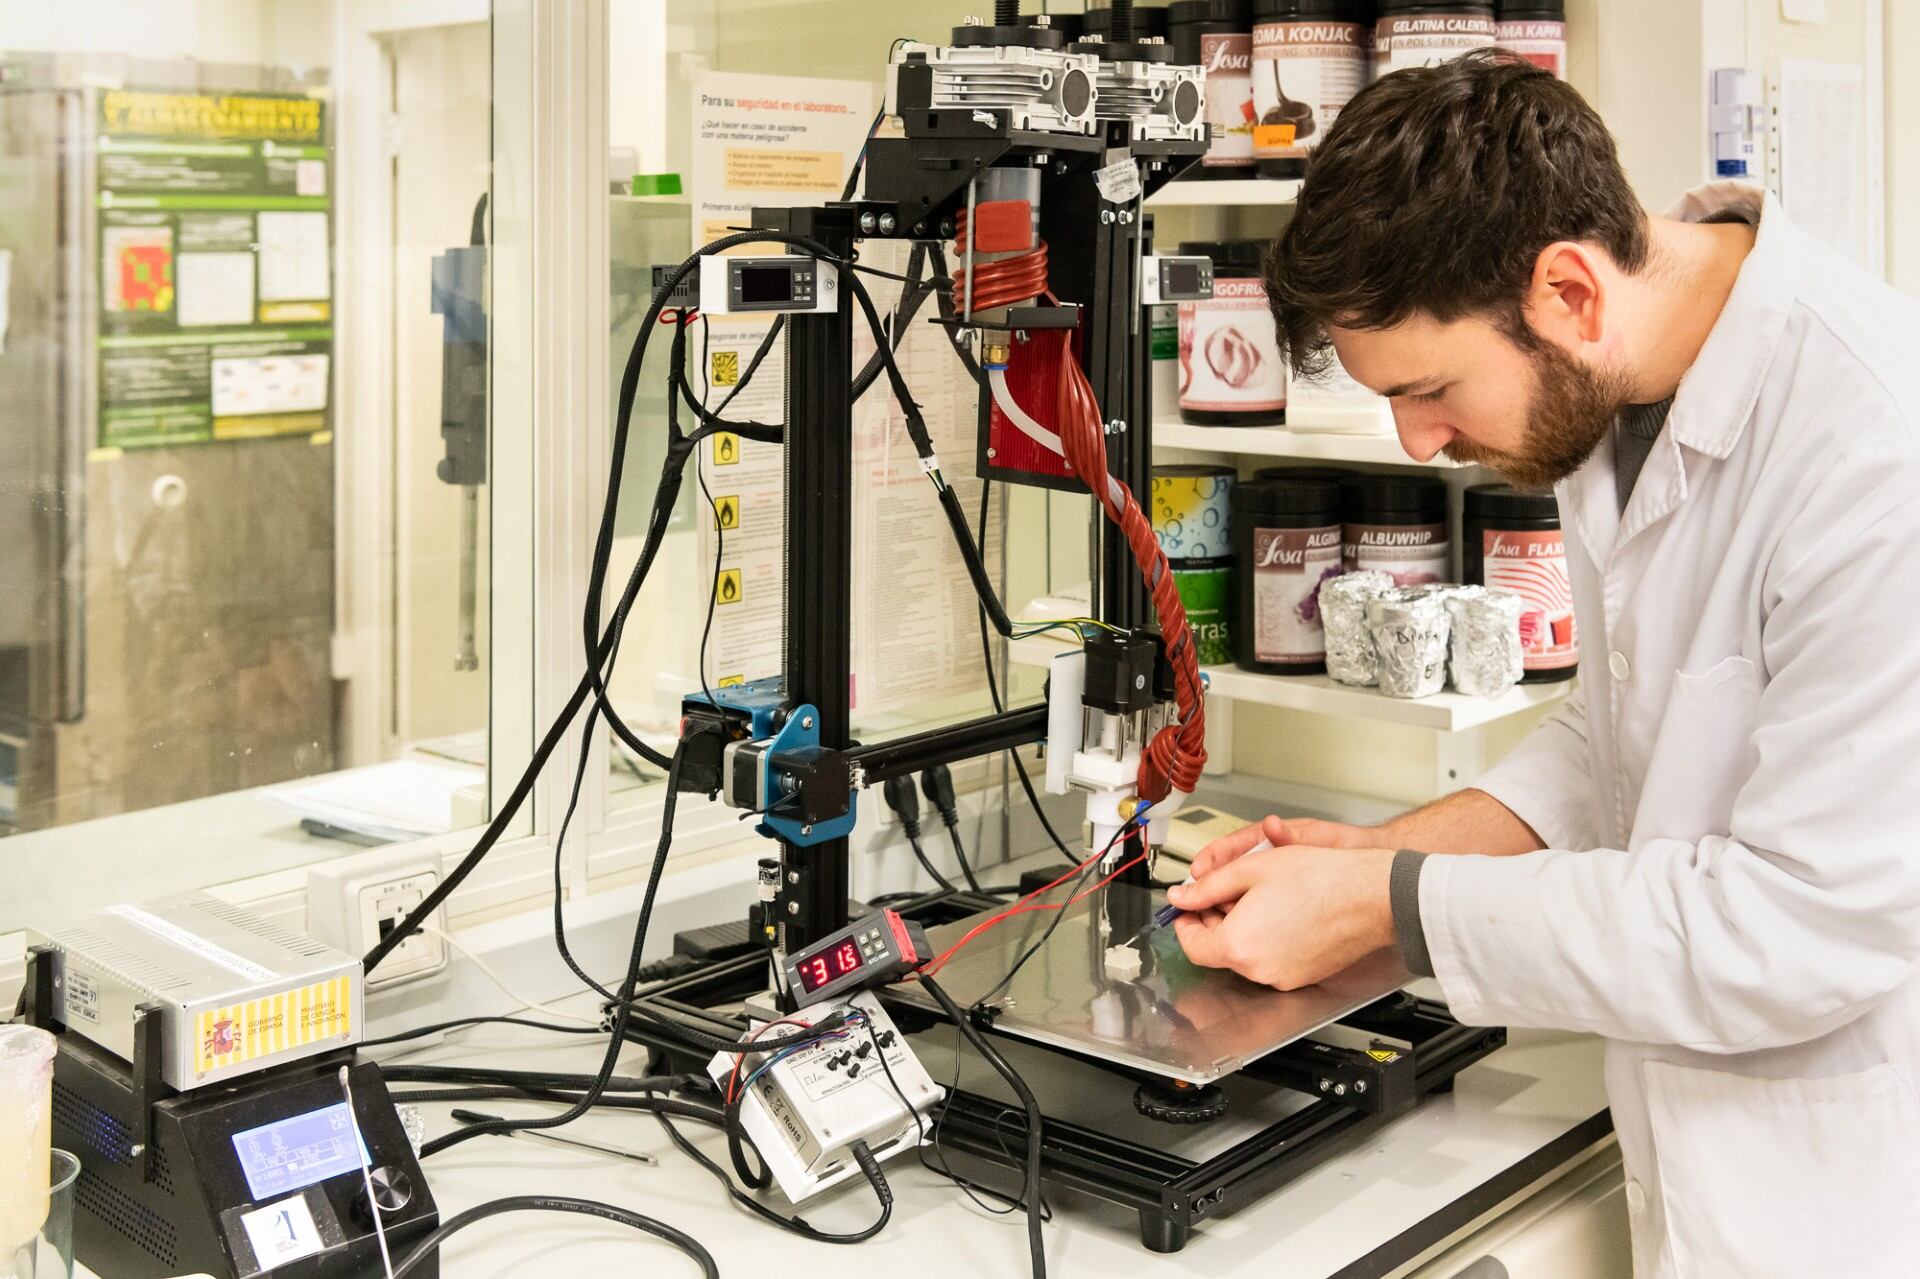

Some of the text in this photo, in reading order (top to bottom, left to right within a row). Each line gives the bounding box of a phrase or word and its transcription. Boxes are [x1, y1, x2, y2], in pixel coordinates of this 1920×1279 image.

[1393, 20, 1445, 33] GELATINA
[1526, 26, 1562, 38] KAPPA
[1288, 26, 1353, 42] KONJAC
[701, 94, 722, 107] Para
[724, 97, 735, 107] su
[736, 97, 779, 111] seguridad
[781, 101, 792, 110] en
[794, 101, 801, 111] el
[803, 102, 848, 113] laboratorio
[722, 120, 739, 129] hacer
[777, 123, 807, 132] accidente
[1360, 531, 1432, 544] ALBUWHIP
[1255, 534, 1302, 567] Sosa
[301, 1000, 335, 1014] MINISTERIO
[248, 1013, 284, 1028] GOBIERNO
[783, 1115, 801, 1142] RoHS
